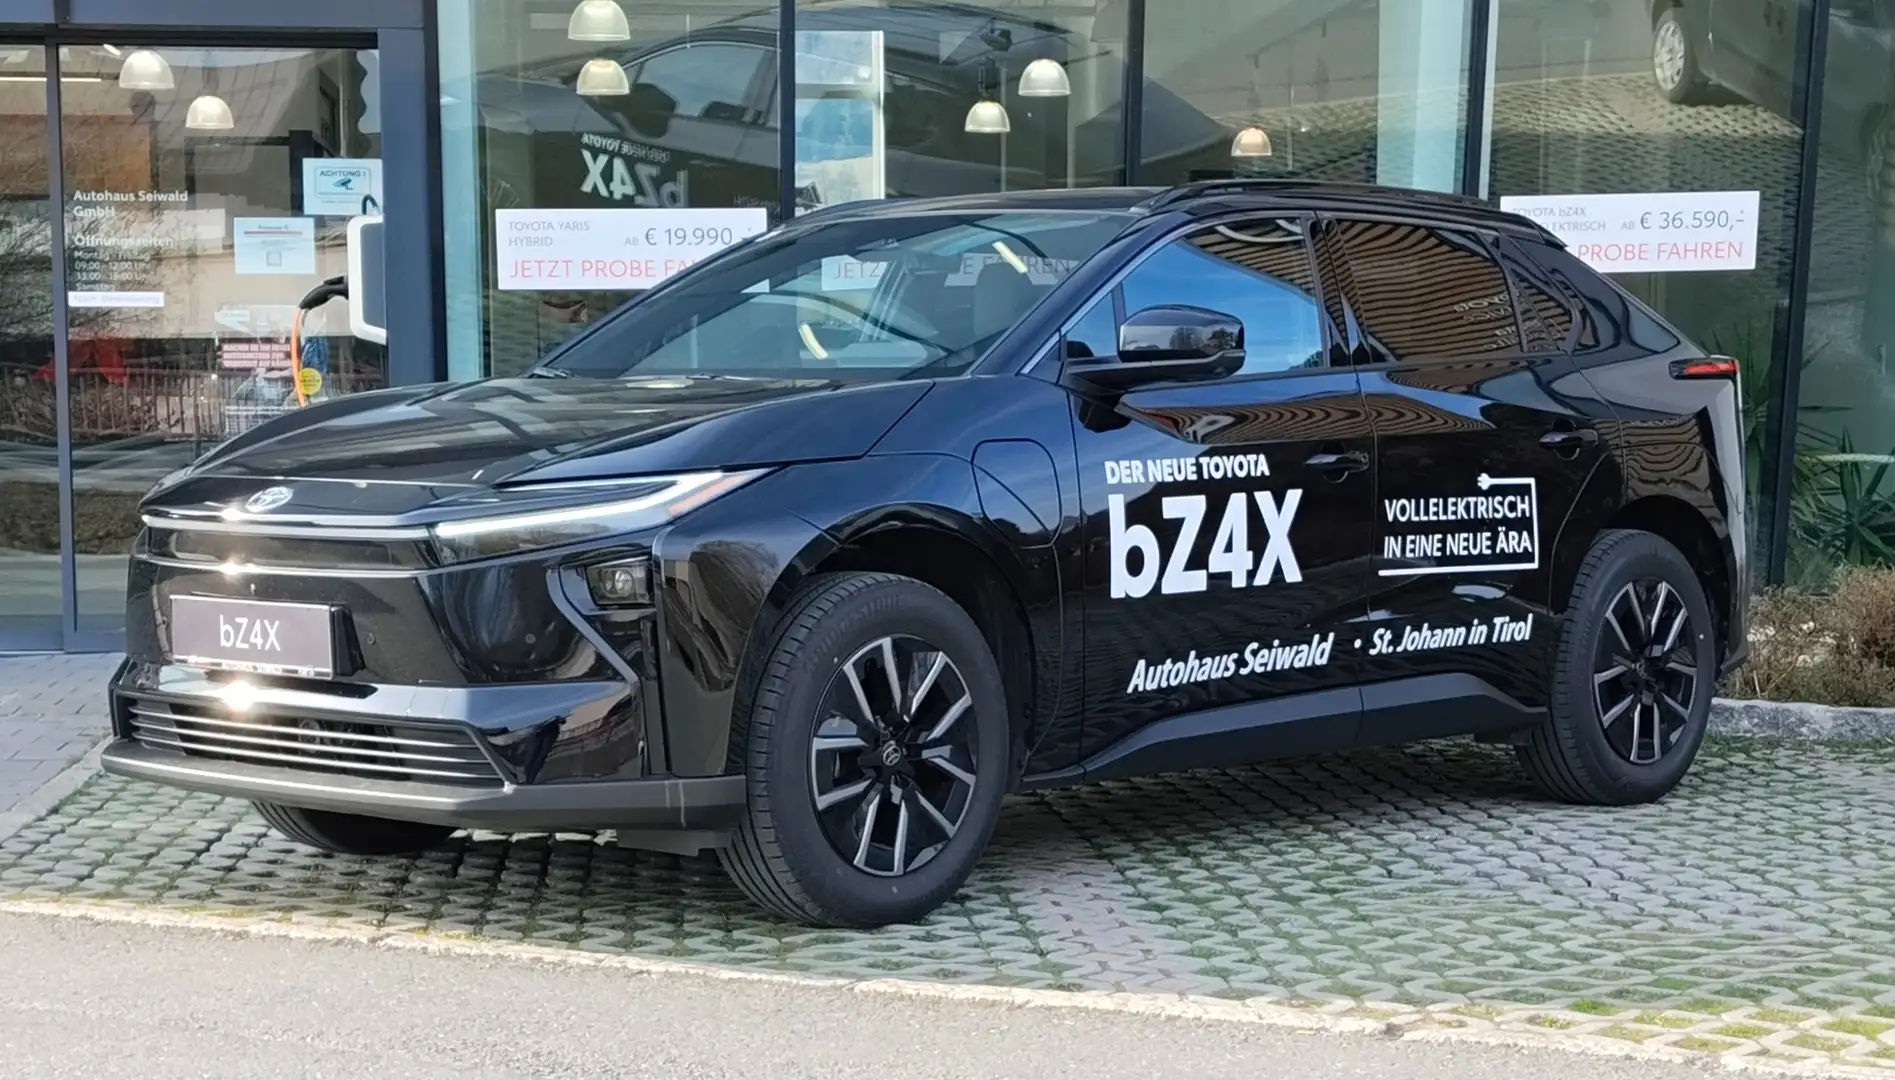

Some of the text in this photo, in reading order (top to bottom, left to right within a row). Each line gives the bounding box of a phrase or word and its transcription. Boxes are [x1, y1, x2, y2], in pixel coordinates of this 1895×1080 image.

[73, 190, 189, 201] Autohaus Seiwald
[73, 206, 115, 217] GmbH
[1558, 206, 1587, 217] bZ4X
[508, 220, 590, 232] TOYOTA YARIS
[1620, 220, 1636, 231] AB
[1640, 212, 1653, 230] €
[508, 237, 553, 247] HYBRID
[624, 237, 639, 246] AB
[645, 227, 658, 246] €
[1578, 241, 1743, 261] PROBE FAHREN
[509, 260, 574, 278] JETZT
[581, 259, 657, 278] PROBE
[834, 261, 882, 279] JETZ
[1105, 453, 1270, 485] DER NEUE TOYOTA
[1384, 495, 1531, 523] VOLLELEKTRISCH
[1108, 489, 1304, 600] bZ4X
[1384, 526, 1533, 559] IN EINE NEUE ÄRA
[219, 614, 281, 652] bZ4X
[1127, 613, 1534, 694] Autohaus Seiwald St. Johann in Tirol
